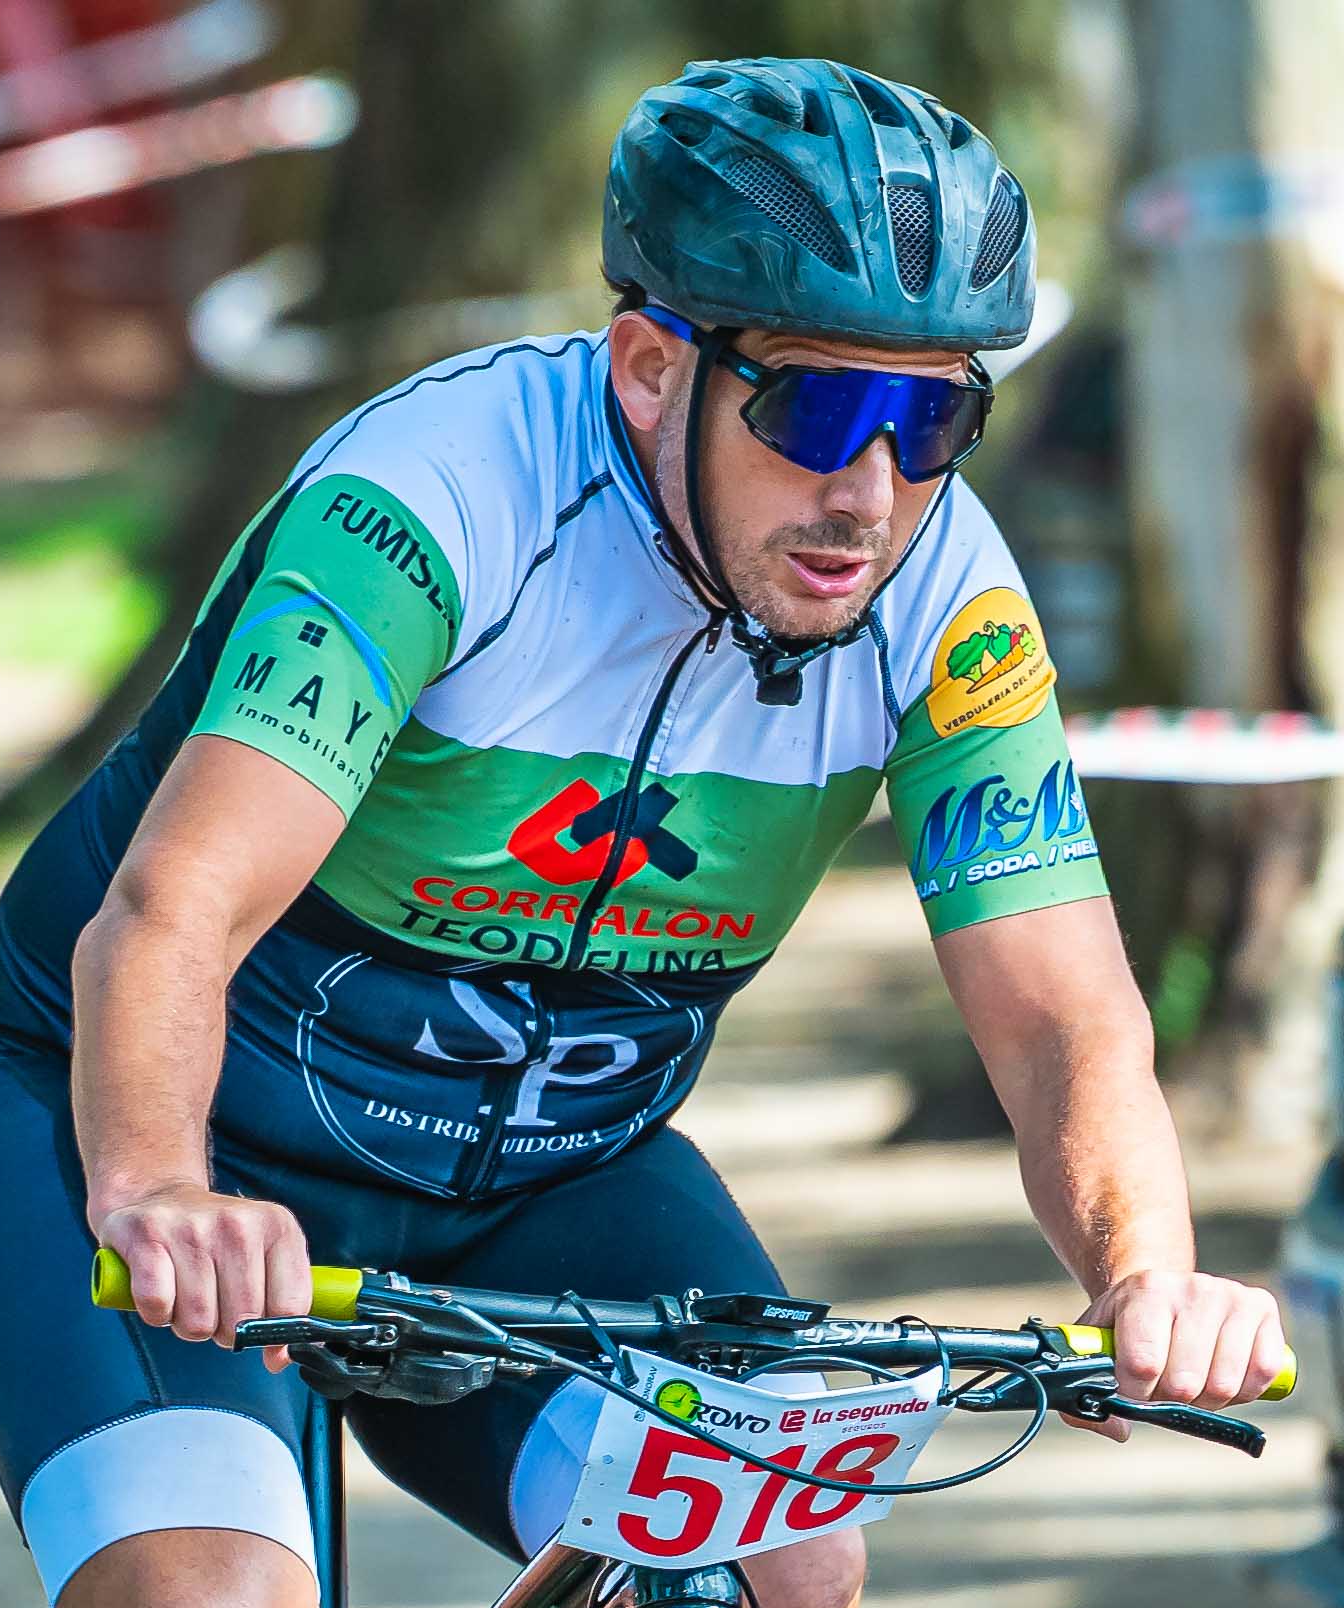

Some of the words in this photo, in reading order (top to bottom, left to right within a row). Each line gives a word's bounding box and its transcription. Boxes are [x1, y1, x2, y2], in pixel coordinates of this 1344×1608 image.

[966, 851, 1042, 886] SODA
[811, 1408, 833, 1425] la
[835, 1397, 930, 1422] segunda
[617, 1426, 901, 1557] 518
